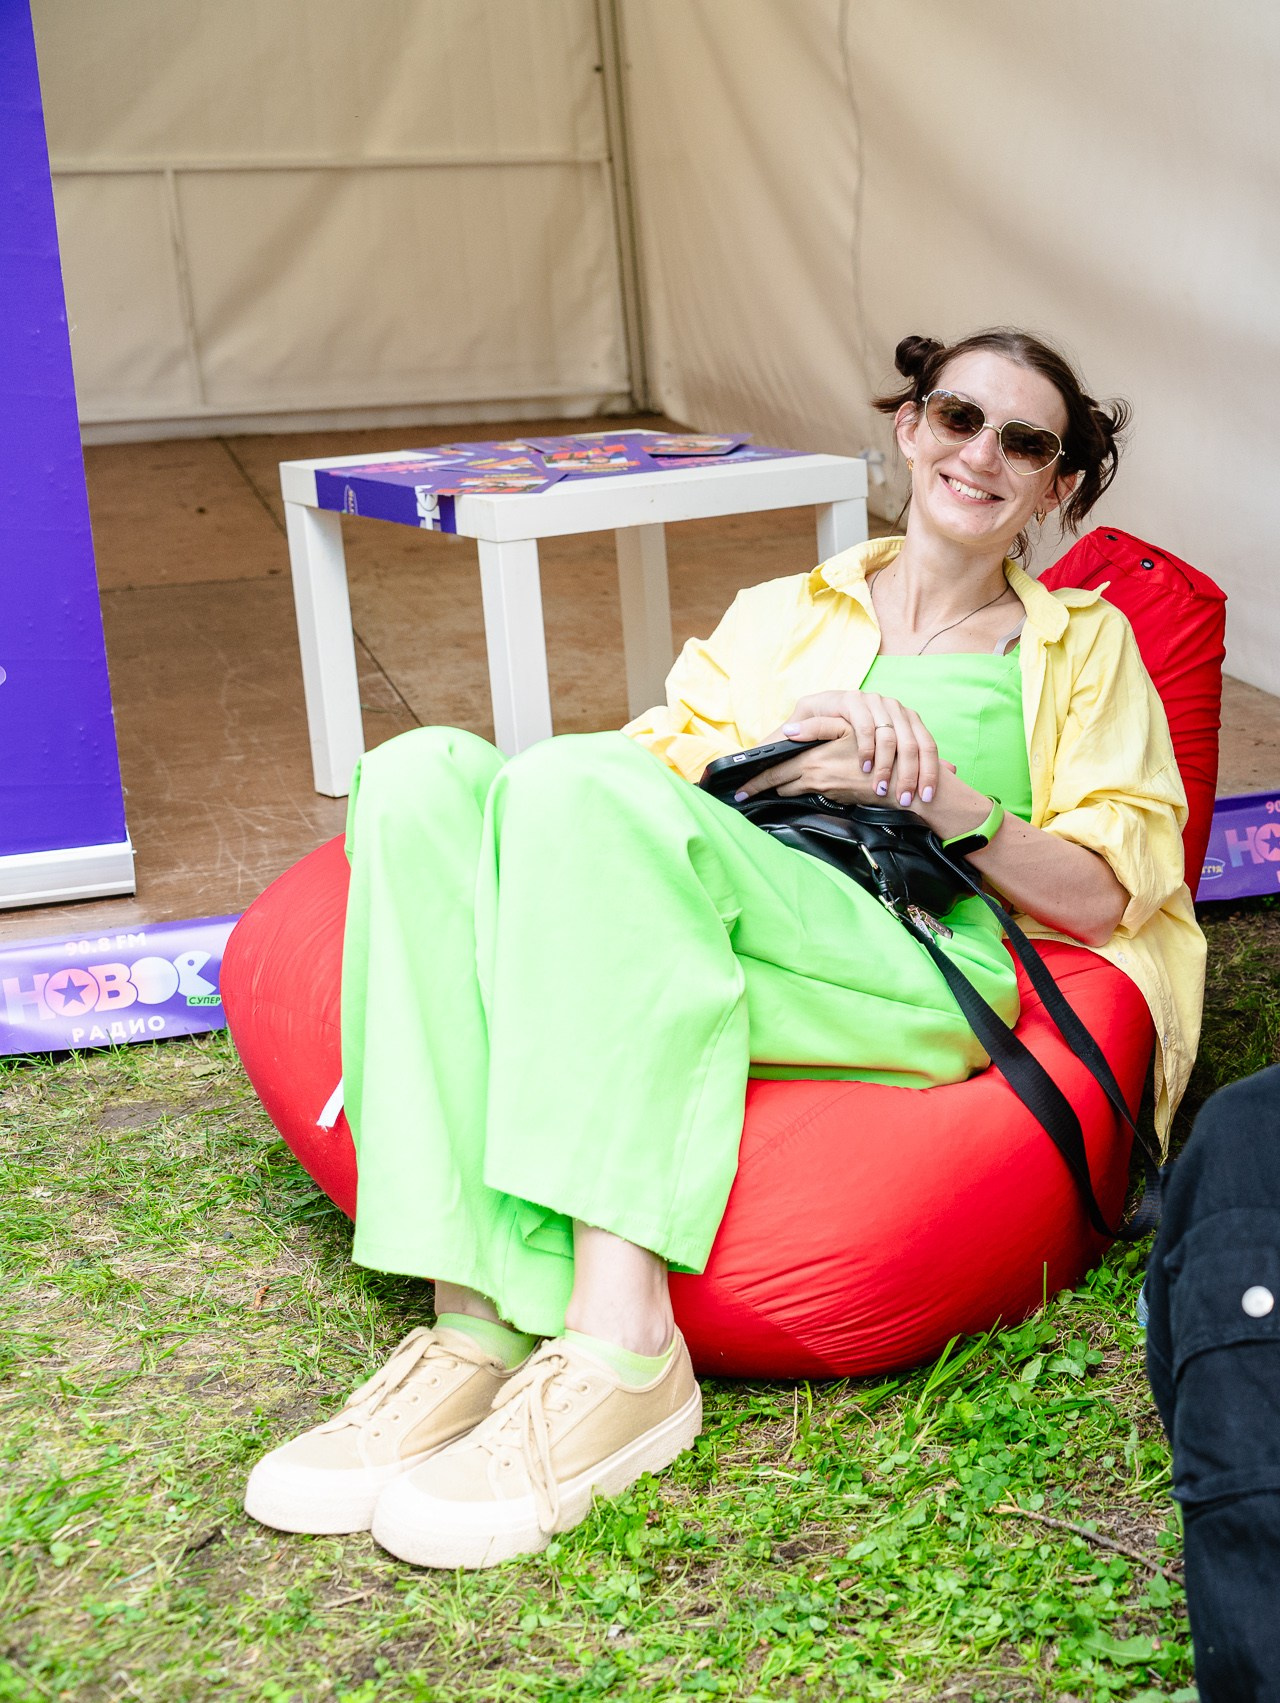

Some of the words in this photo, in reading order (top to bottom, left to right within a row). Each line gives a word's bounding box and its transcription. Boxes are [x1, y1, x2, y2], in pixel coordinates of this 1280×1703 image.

[64, 937, 111, 956] 90.8
[116, 932, 146, 949] FM
[188, 996, 221, 1005] СУПЕР
[72, 1016, 165, 1043] РАДИО
